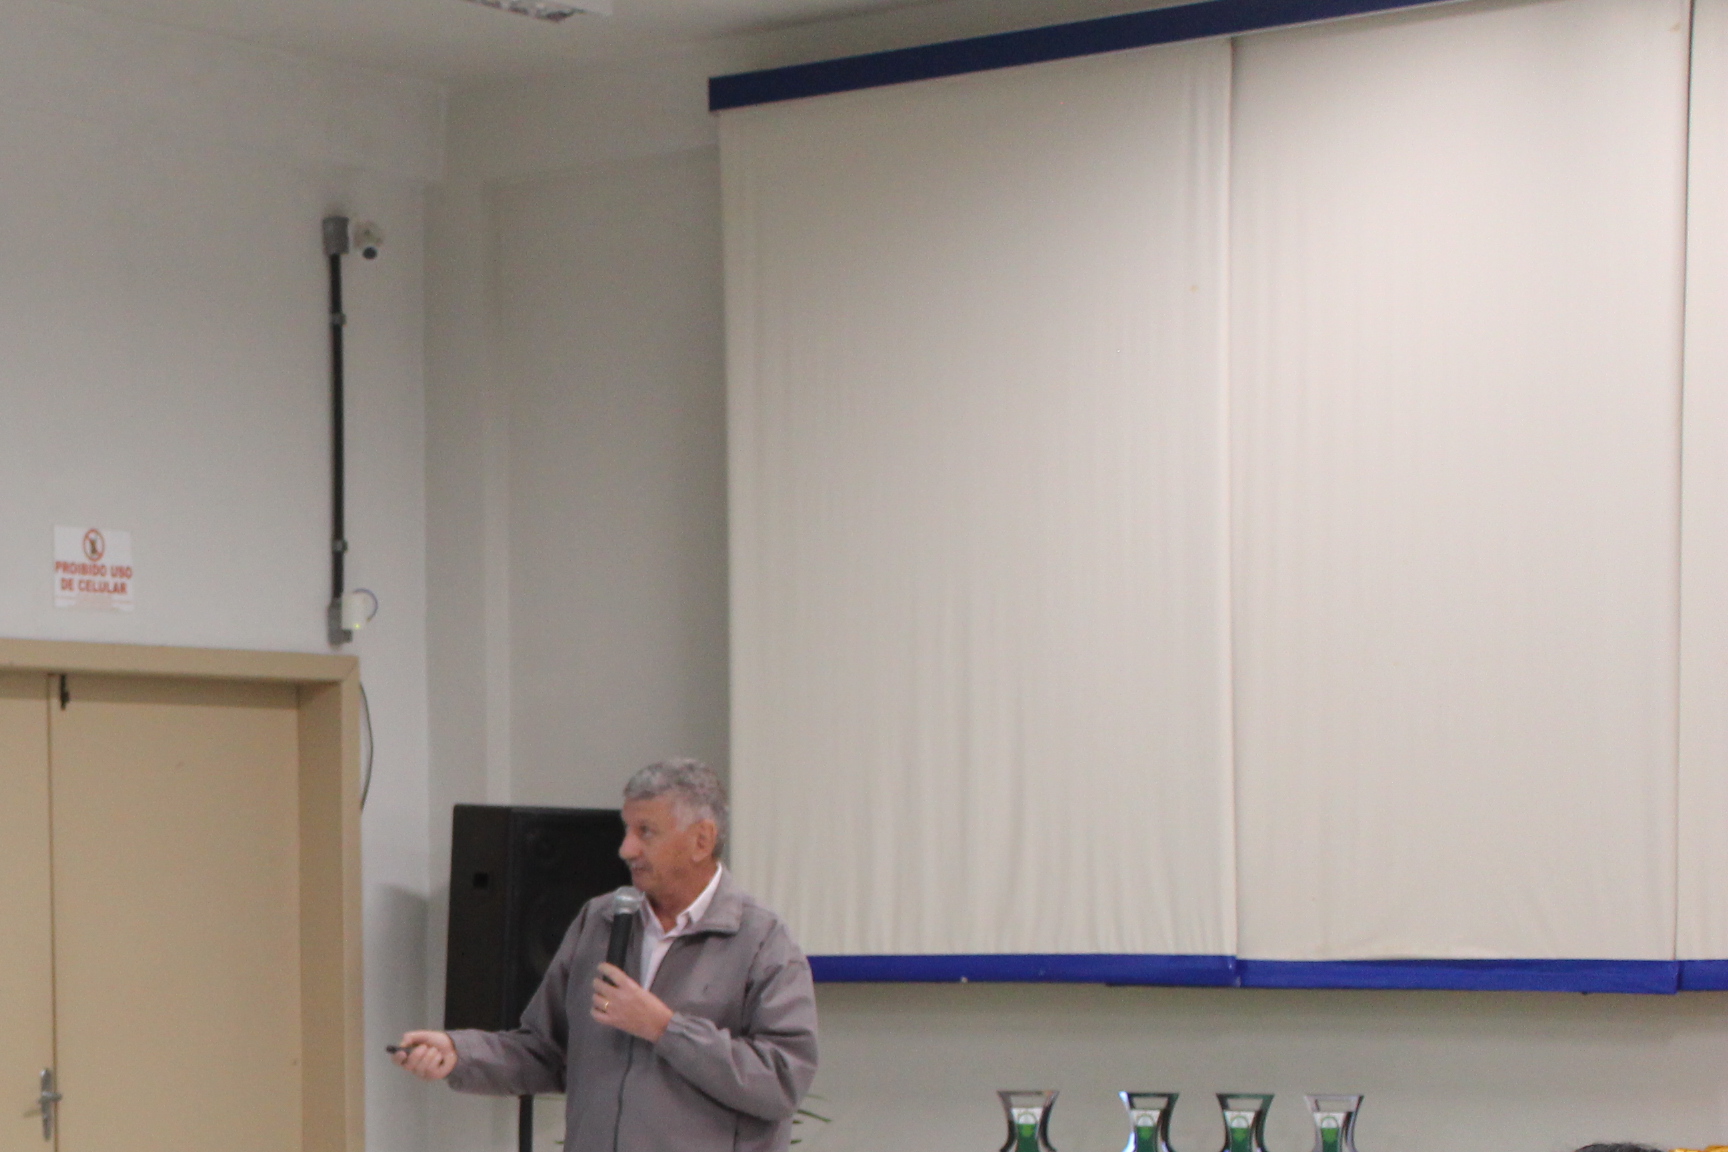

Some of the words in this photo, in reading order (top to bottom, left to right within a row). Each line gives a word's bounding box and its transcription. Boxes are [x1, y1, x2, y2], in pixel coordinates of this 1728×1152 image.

[54, 561, 107, 577] PROIBIDO
[111, 565, 133, 579] USO
[60, 578, 74, 591] DE
[78, 579, 128, 595] CELULAR
